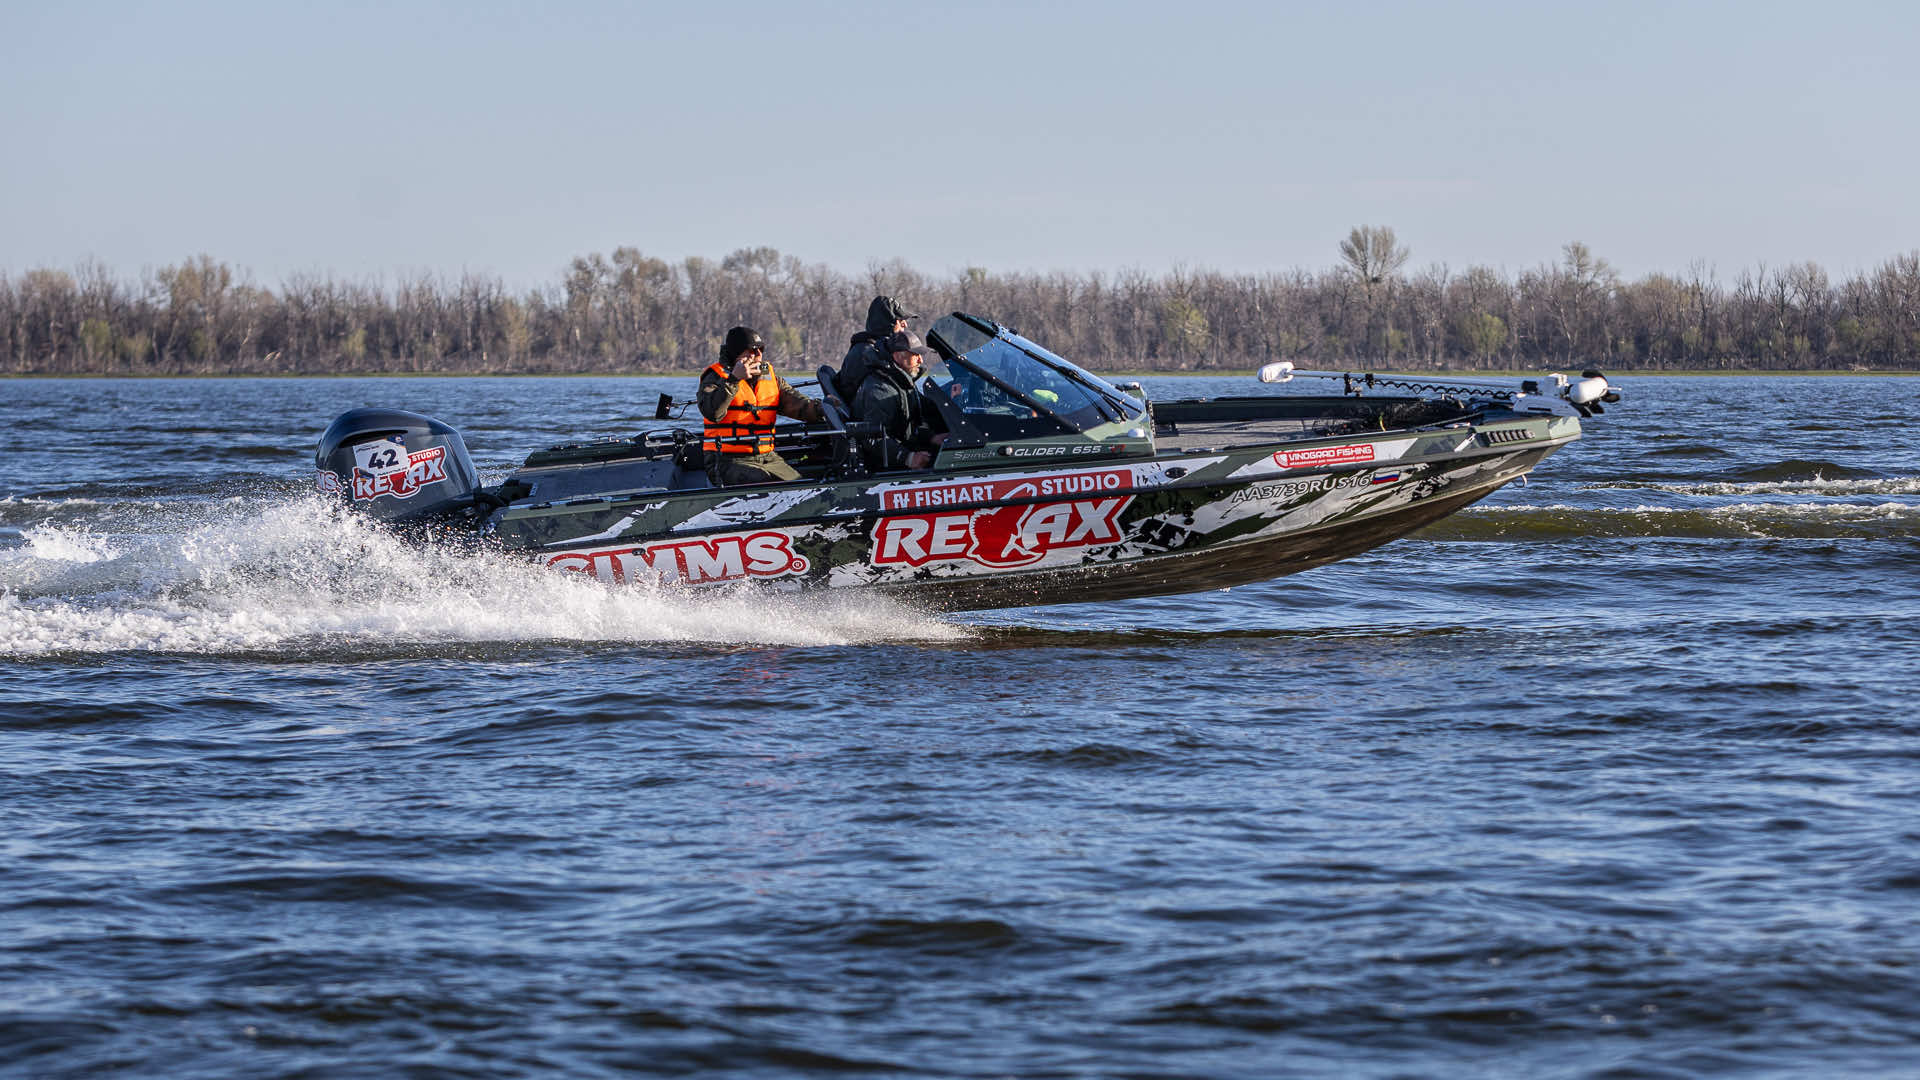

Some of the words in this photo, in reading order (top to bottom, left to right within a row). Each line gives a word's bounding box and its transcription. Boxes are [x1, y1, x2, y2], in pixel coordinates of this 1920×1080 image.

[411, 449, 441, 462] STUDIO
[1014, 446, 1066, 457] GLIDER
[1072, 445, 1102, 454] 655
[1336, 446, 1372, 457] FISHING
[368, 449, 399, 470] 42
[914, 485, 994, 507] FISHART
[1041, 473, 1121, 496] STUDIO
